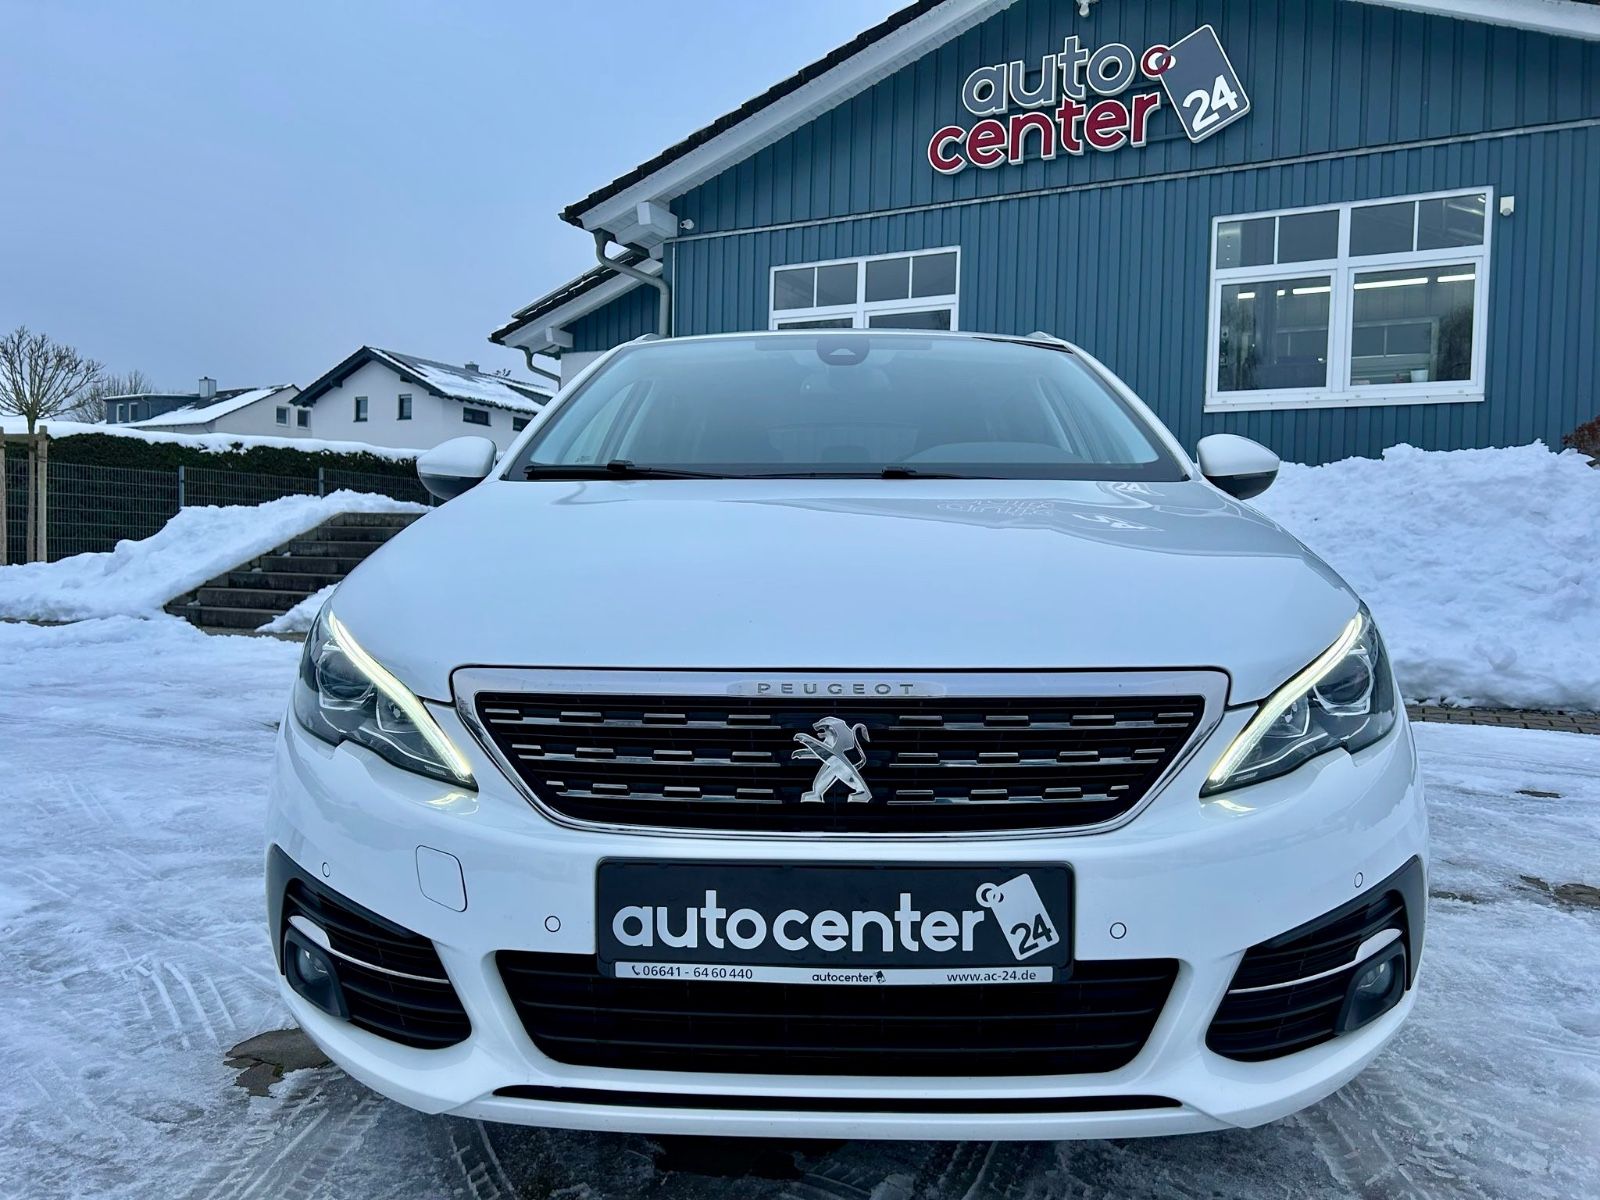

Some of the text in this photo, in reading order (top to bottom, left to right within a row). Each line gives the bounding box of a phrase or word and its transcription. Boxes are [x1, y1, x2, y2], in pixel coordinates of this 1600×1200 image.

[962, 35, 1136, 116] auto
[1182, 74, 1239, 133] 24
[928, 92, 1161, 175] center
[757, 682, 914, 695] PEUGEOT
[1010, 913, 1053, 955] 24
[811, 971, 873, 983] autocenter
[946, 969, 1037, 982] www.ac-24.de
